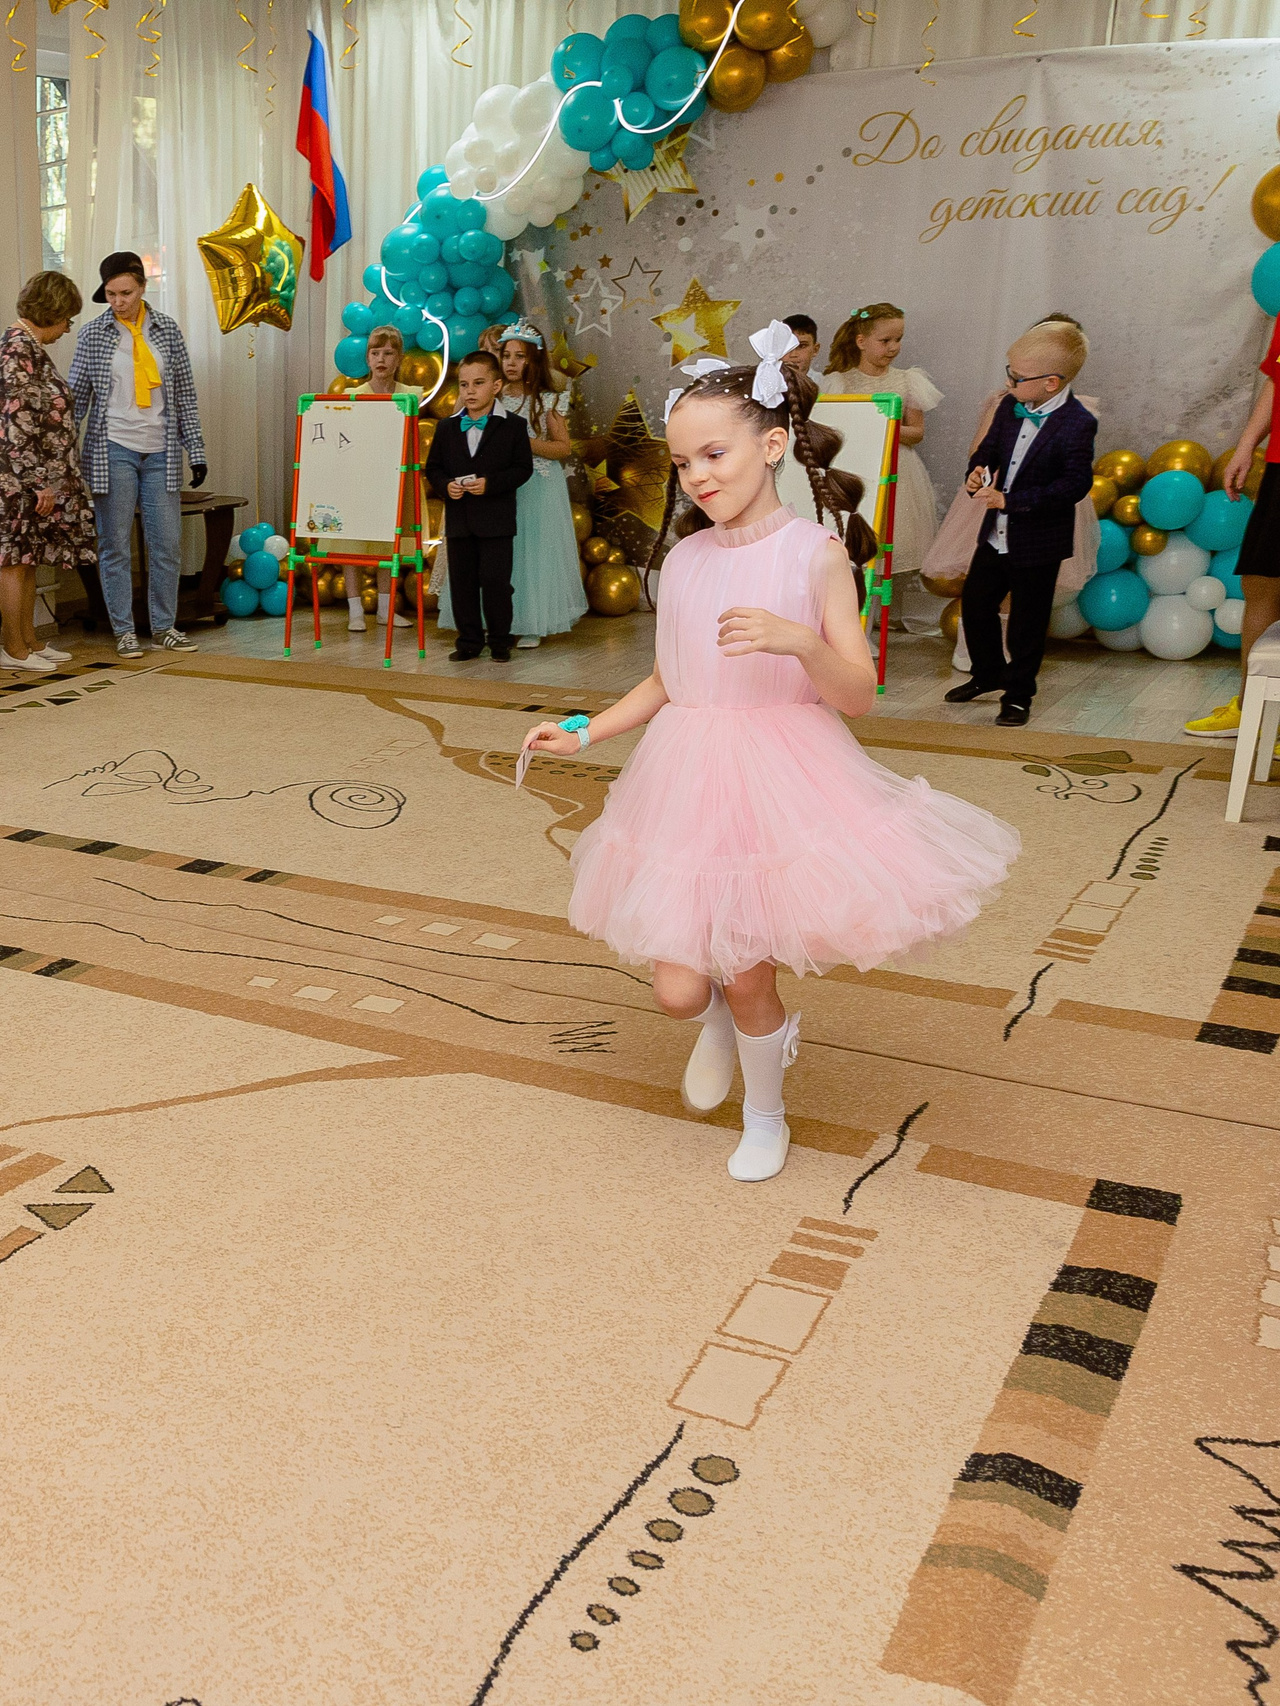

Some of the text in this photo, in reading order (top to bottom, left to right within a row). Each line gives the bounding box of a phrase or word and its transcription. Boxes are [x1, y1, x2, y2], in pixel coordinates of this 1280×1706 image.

[852, 94, 1165, 174] До свидания,
[919, 164, 1239, 243] детский сад!
